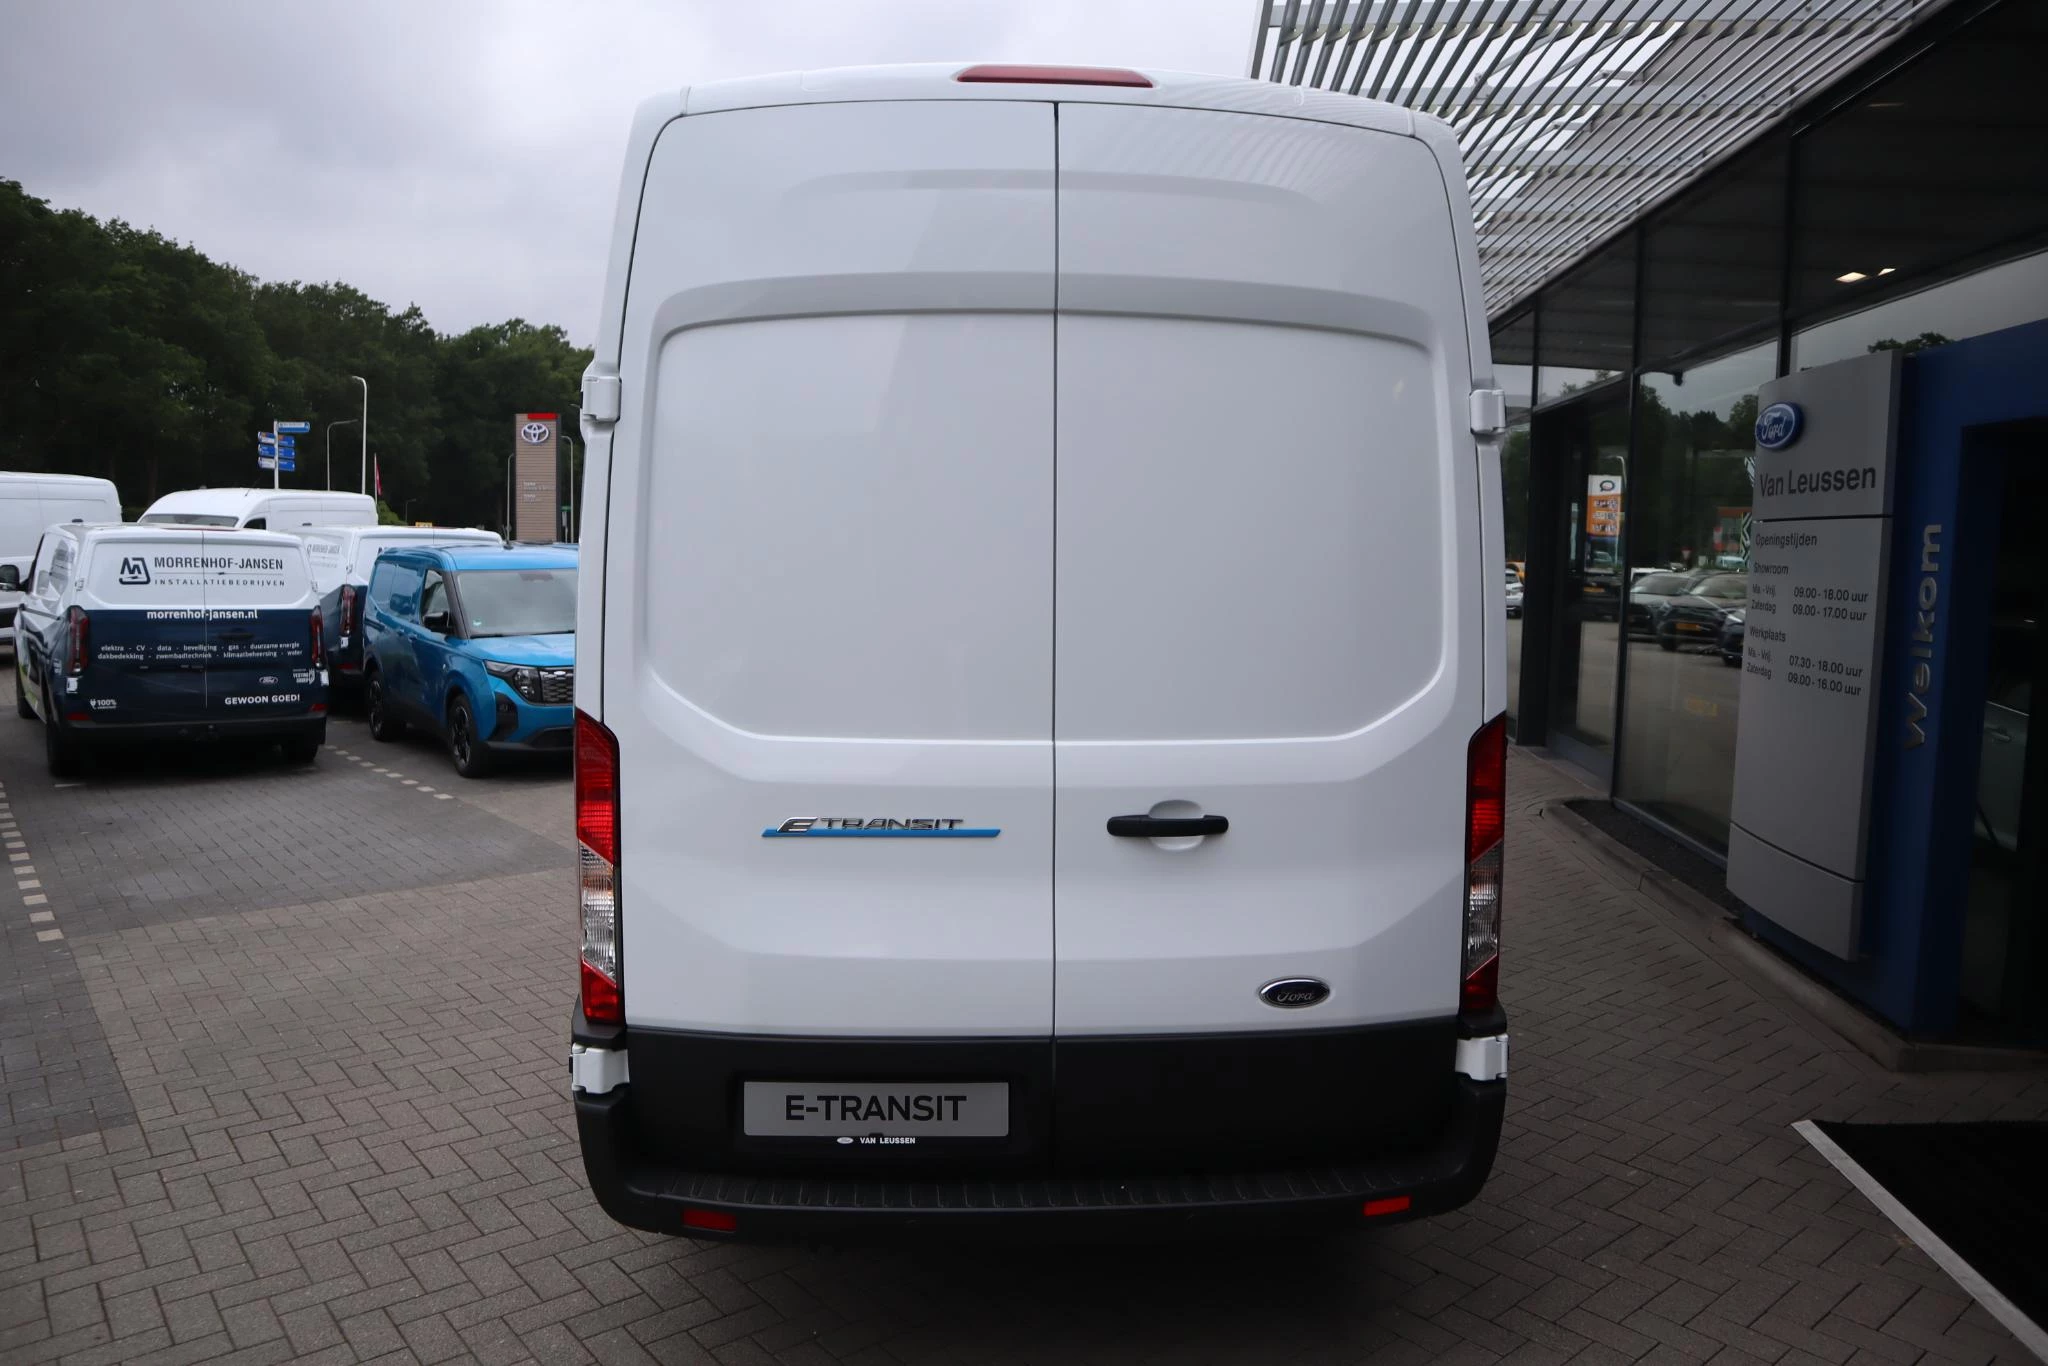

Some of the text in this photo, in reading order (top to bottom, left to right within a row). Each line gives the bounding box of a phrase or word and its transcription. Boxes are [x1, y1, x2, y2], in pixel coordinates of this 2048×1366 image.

[1761, 411, 1787, 441] Ford
[1760, 467, 1876, 496] Van Leussen
[1756, 532, 1818, 549] Openingstijden
[154, 557, 284, 570] MORRENHOF-JANSEN
[1754, 562, 1789, 575] Showroom
[1794, 586, 1816, 598] 09.00
[1824, 588, 1849, 600] 18.00
[1852, 592, 1869, 602] uur
[147, 609, 258, 621] morrenhof-jansen.nl
[1752, 599, 1776, 615] Zaterdag
[1792, 604, 1816, 616] 09.00
[1823, 606, 1848, 620] 17.00
[1850, 610, 1868, 621] uur
[1750, 626, 1786, 643] Werkplaats
[1904, 524, 1942, 750] Welkom
[184, 644, 217, 652] beveiliging
[1746, 662, 1772, 680] Zaterdag
[1789, 655, 1811, 668] 07.30
[1818, 660, 1844, 674] 18.00
[1846, 666, 1864, 678] uur
[1788, 672, 1811, 686] 09.00
[1818, 678, 1842, 692] 16.00
[1844, 684, 1862, 696] uur
[224, 694, 300, 705] GEWOON GOED!
[786, 1094, 967, 1121] E-TRANSIT
